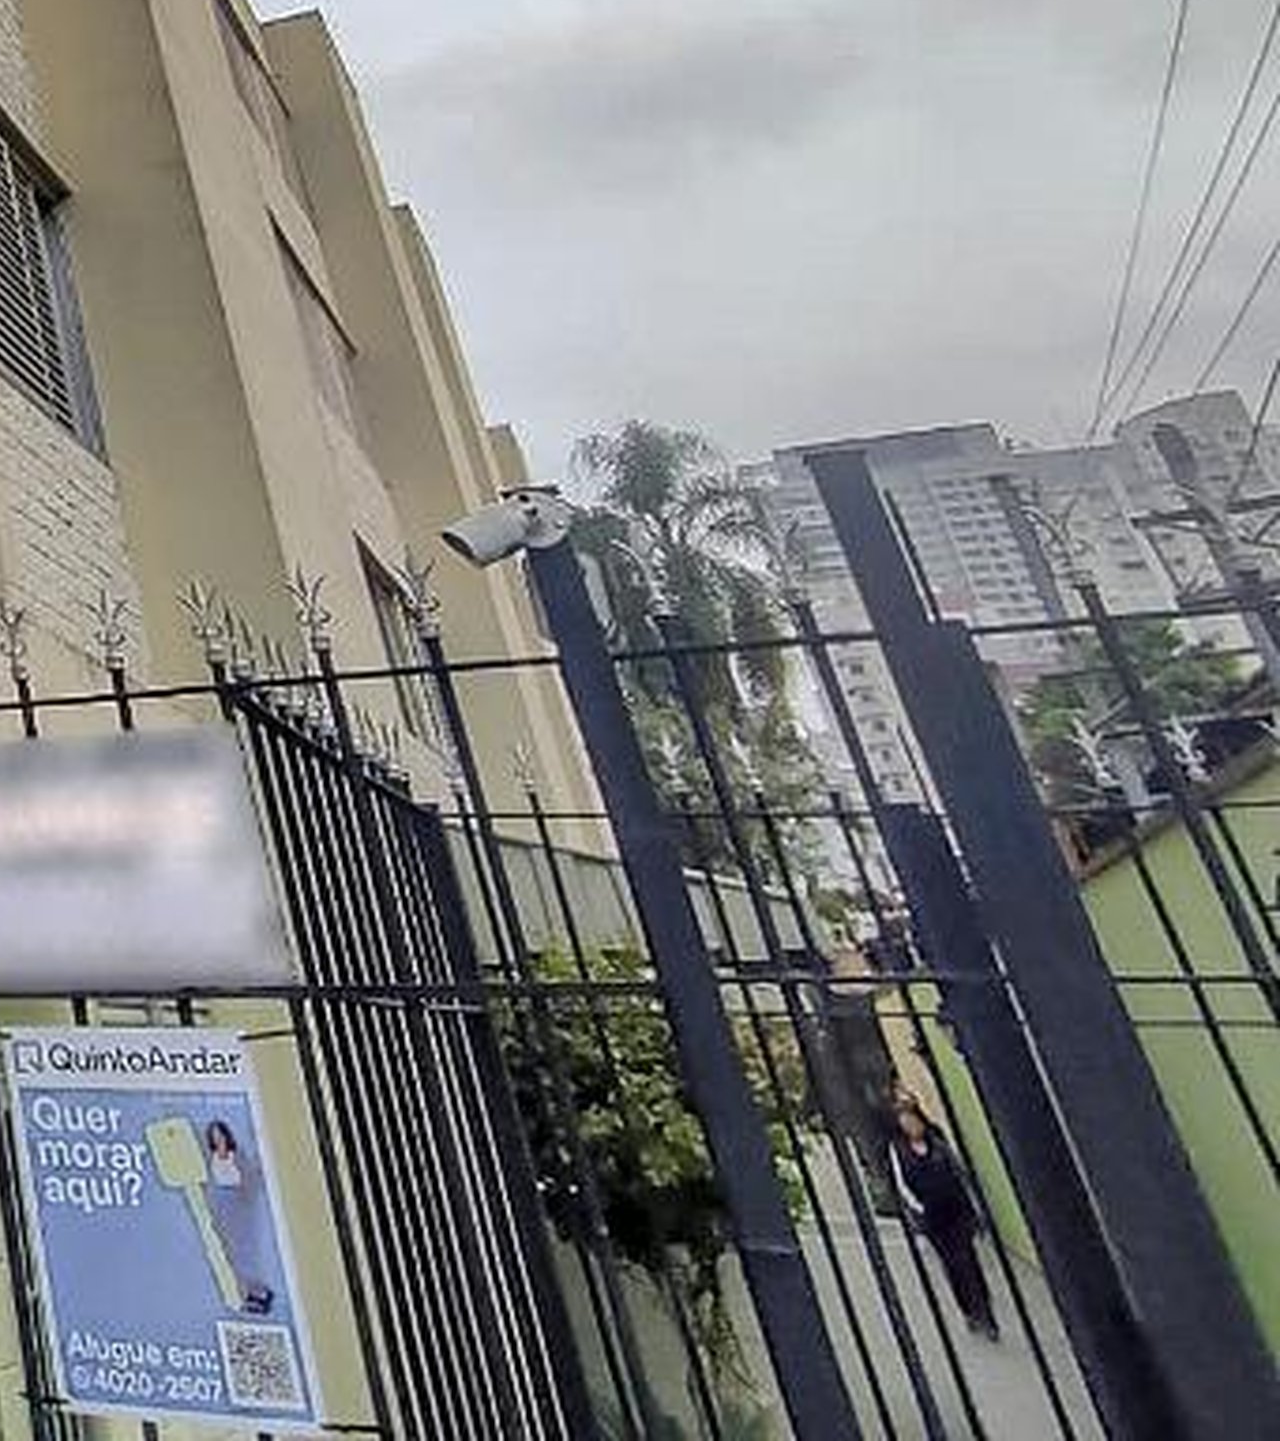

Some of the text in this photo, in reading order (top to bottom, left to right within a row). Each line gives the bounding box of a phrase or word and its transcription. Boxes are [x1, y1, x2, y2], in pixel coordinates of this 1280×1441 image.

[47, 1042, 242, 1075] QuintoAndar
[32, 1097, 122, 1133] Quer
[40, 1139, 146, 1170] morar
[43, 1171, 142, 1213] aqui?
[68, 1330, 221, 1372] Alugue em:
